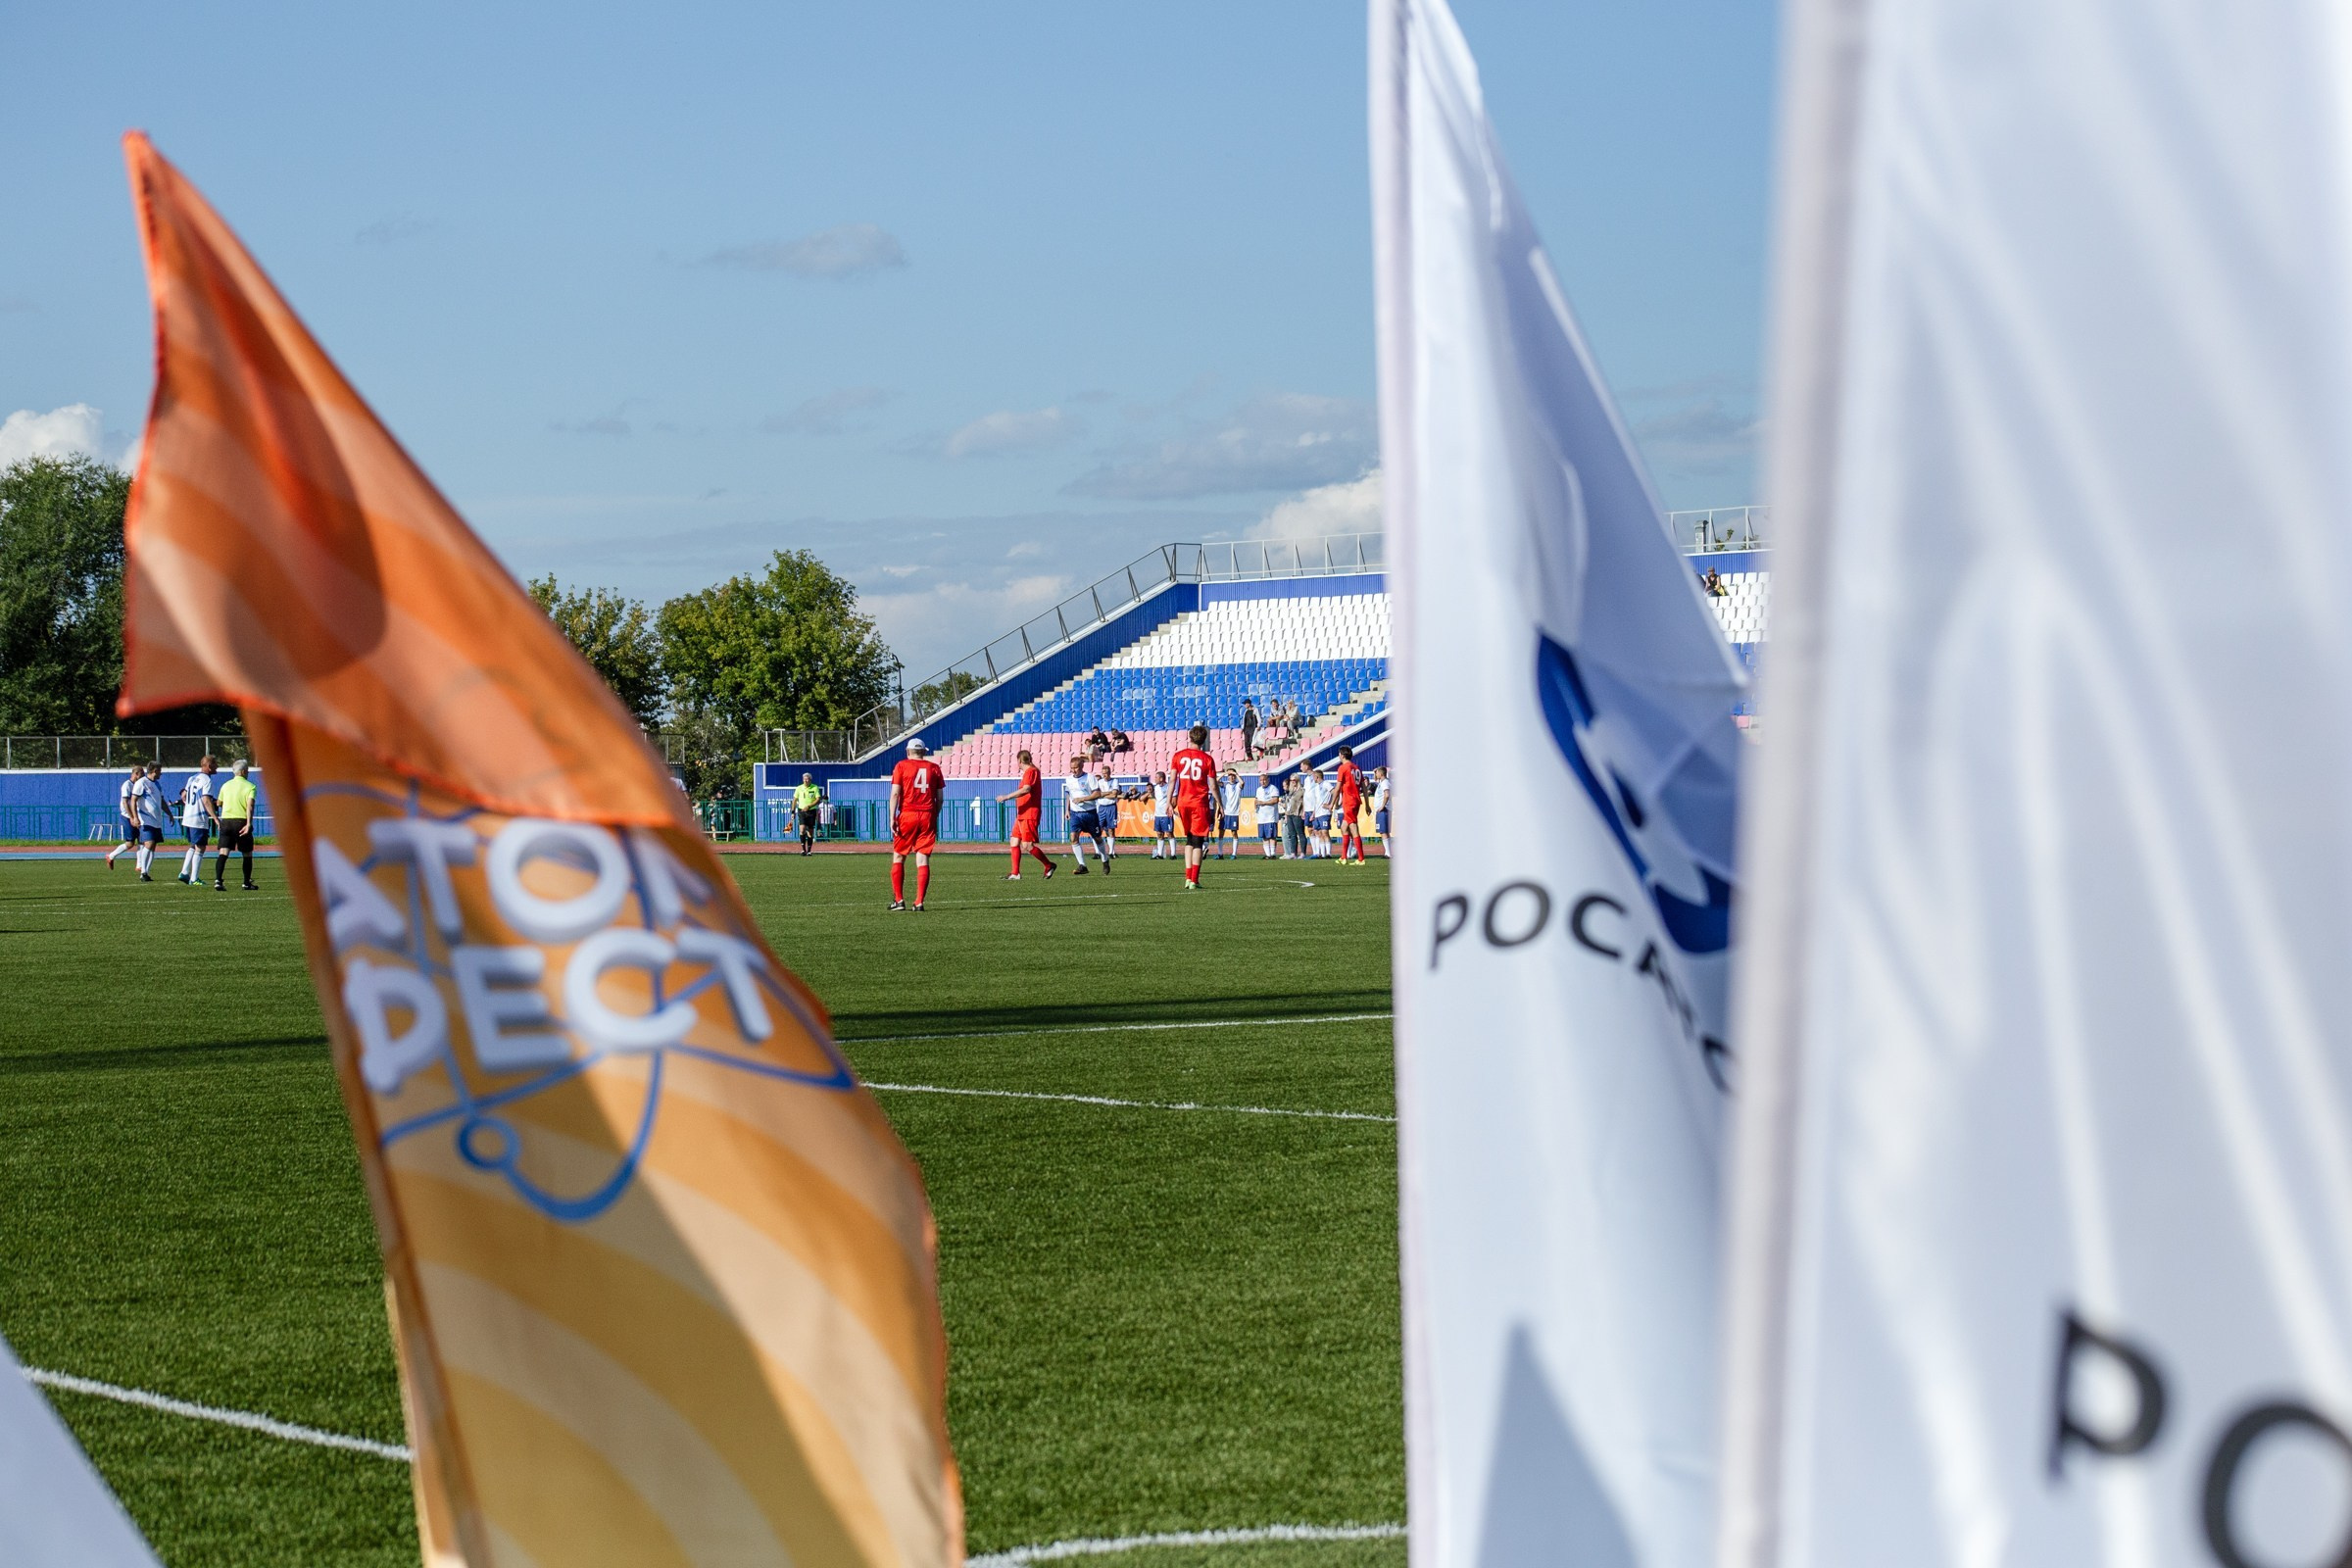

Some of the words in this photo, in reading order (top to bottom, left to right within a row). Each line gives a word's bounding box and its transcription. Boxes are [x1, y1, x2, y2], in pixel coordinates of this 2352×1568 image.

[913, 767, 929, 794] 4
[1179, 757, 1202, 781] 26
[1350, 768, 1361, 785] 19
[970, 796, 981, 826] 1
